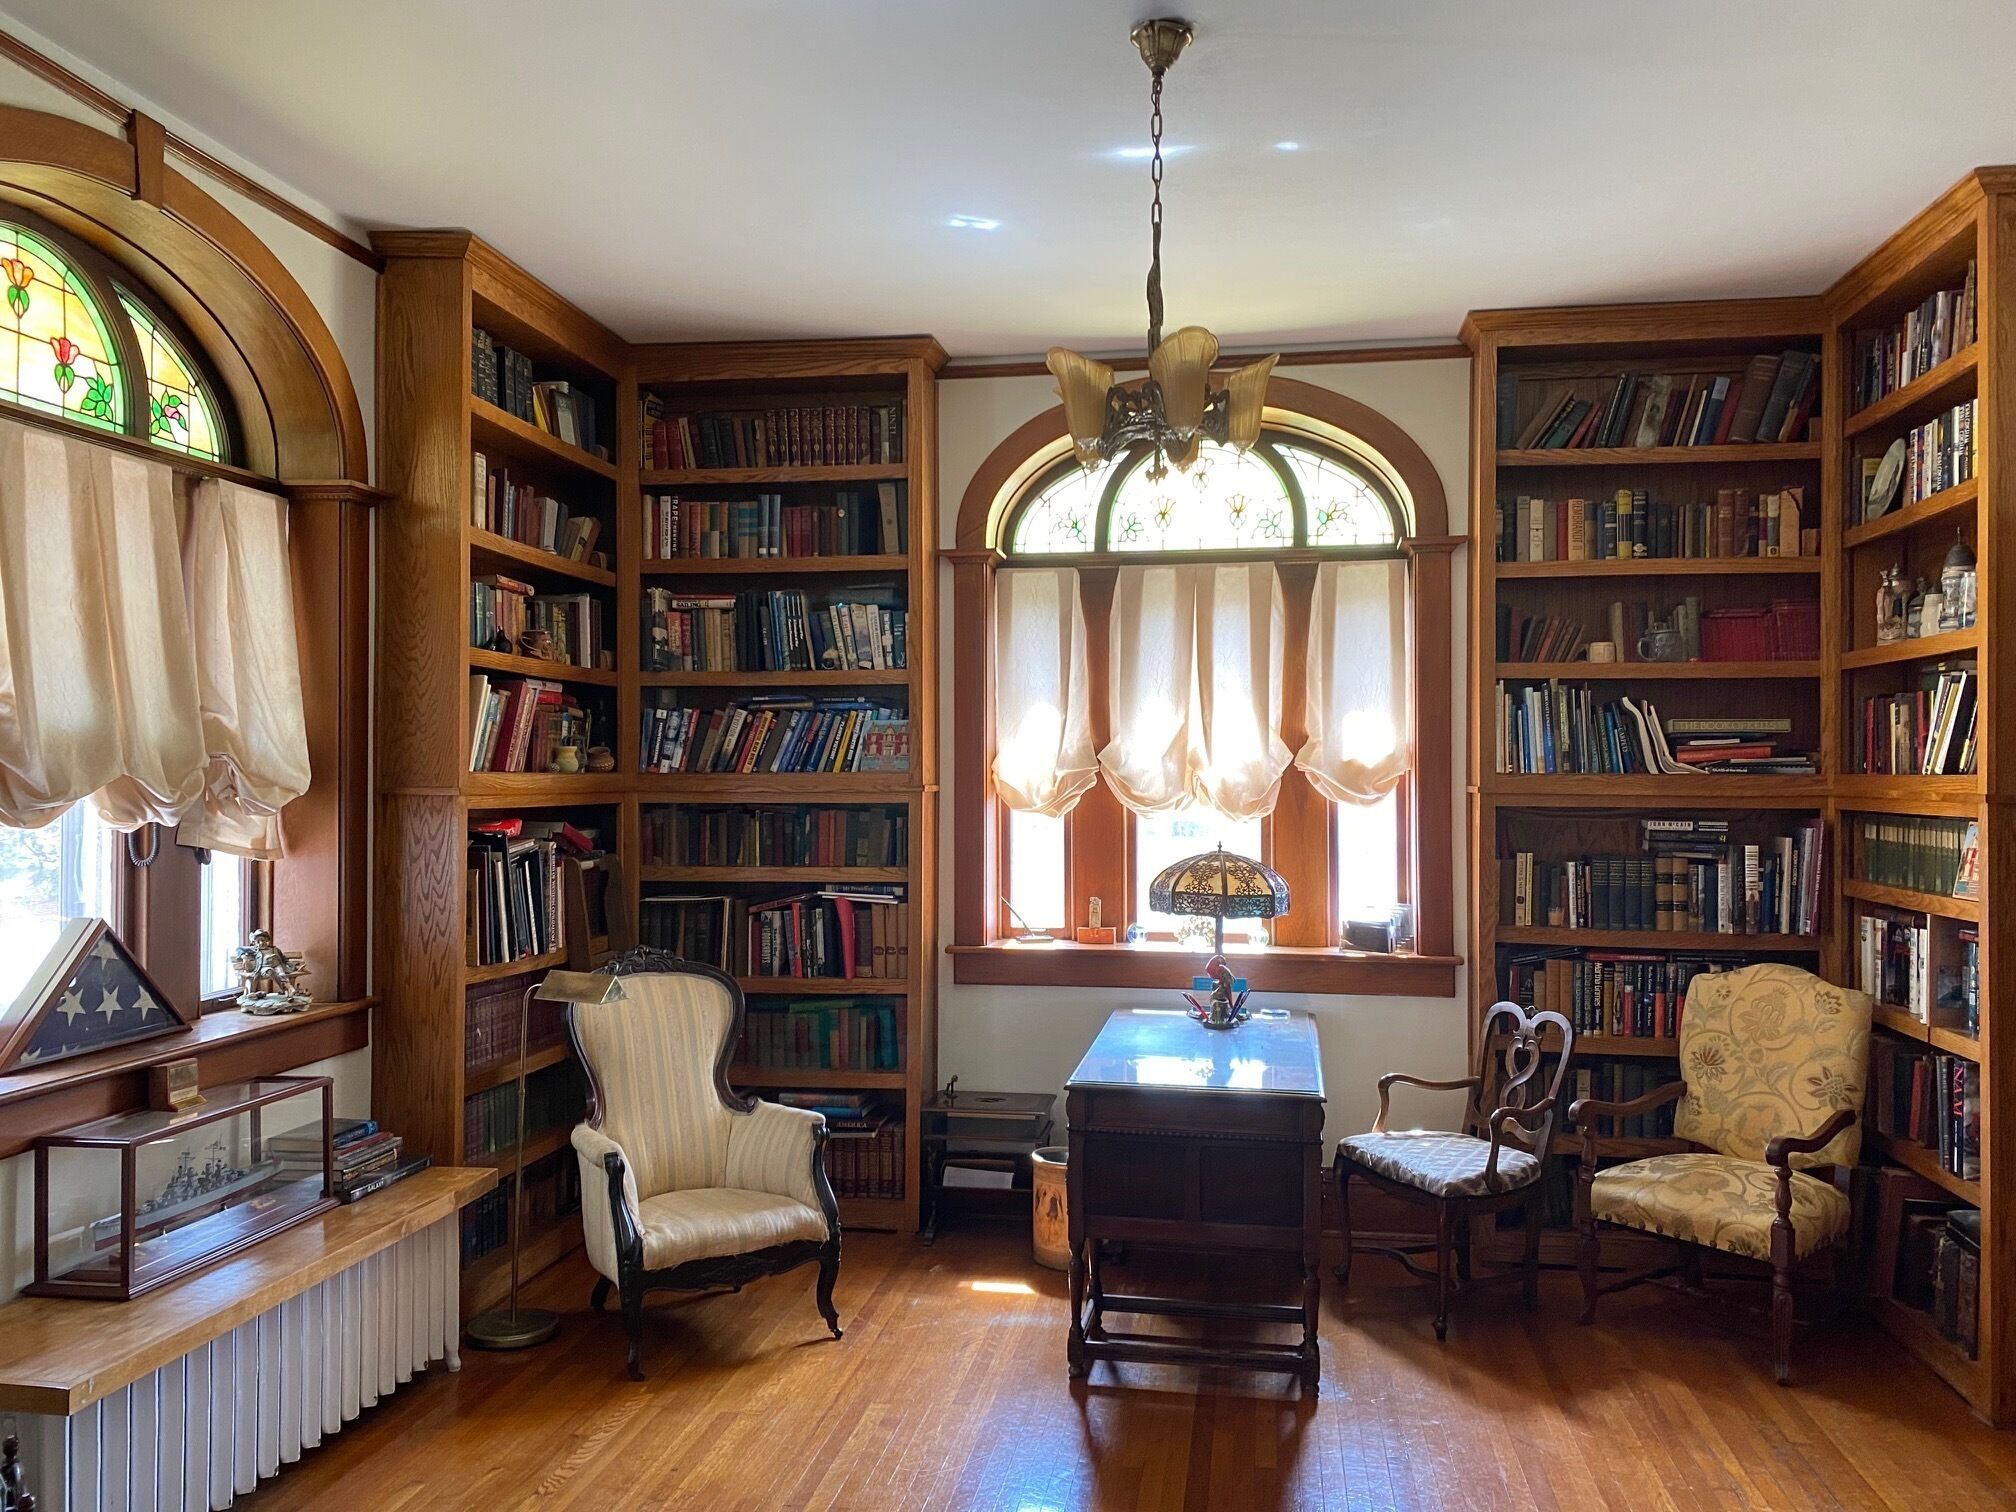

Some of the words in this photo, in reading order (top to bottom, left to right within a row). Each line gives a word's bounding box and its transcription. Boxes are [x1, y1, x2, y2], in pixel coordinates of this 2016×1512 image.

[1573, 501, 1583, 543] REMBRANDT
[729, 710, 744, 738] DEVOTION
[1594, 961, 1603, 984] Martha
[1594, 985, 1602, 1007] Grimes
[1954, 1066, 1964, 1117] NAM
